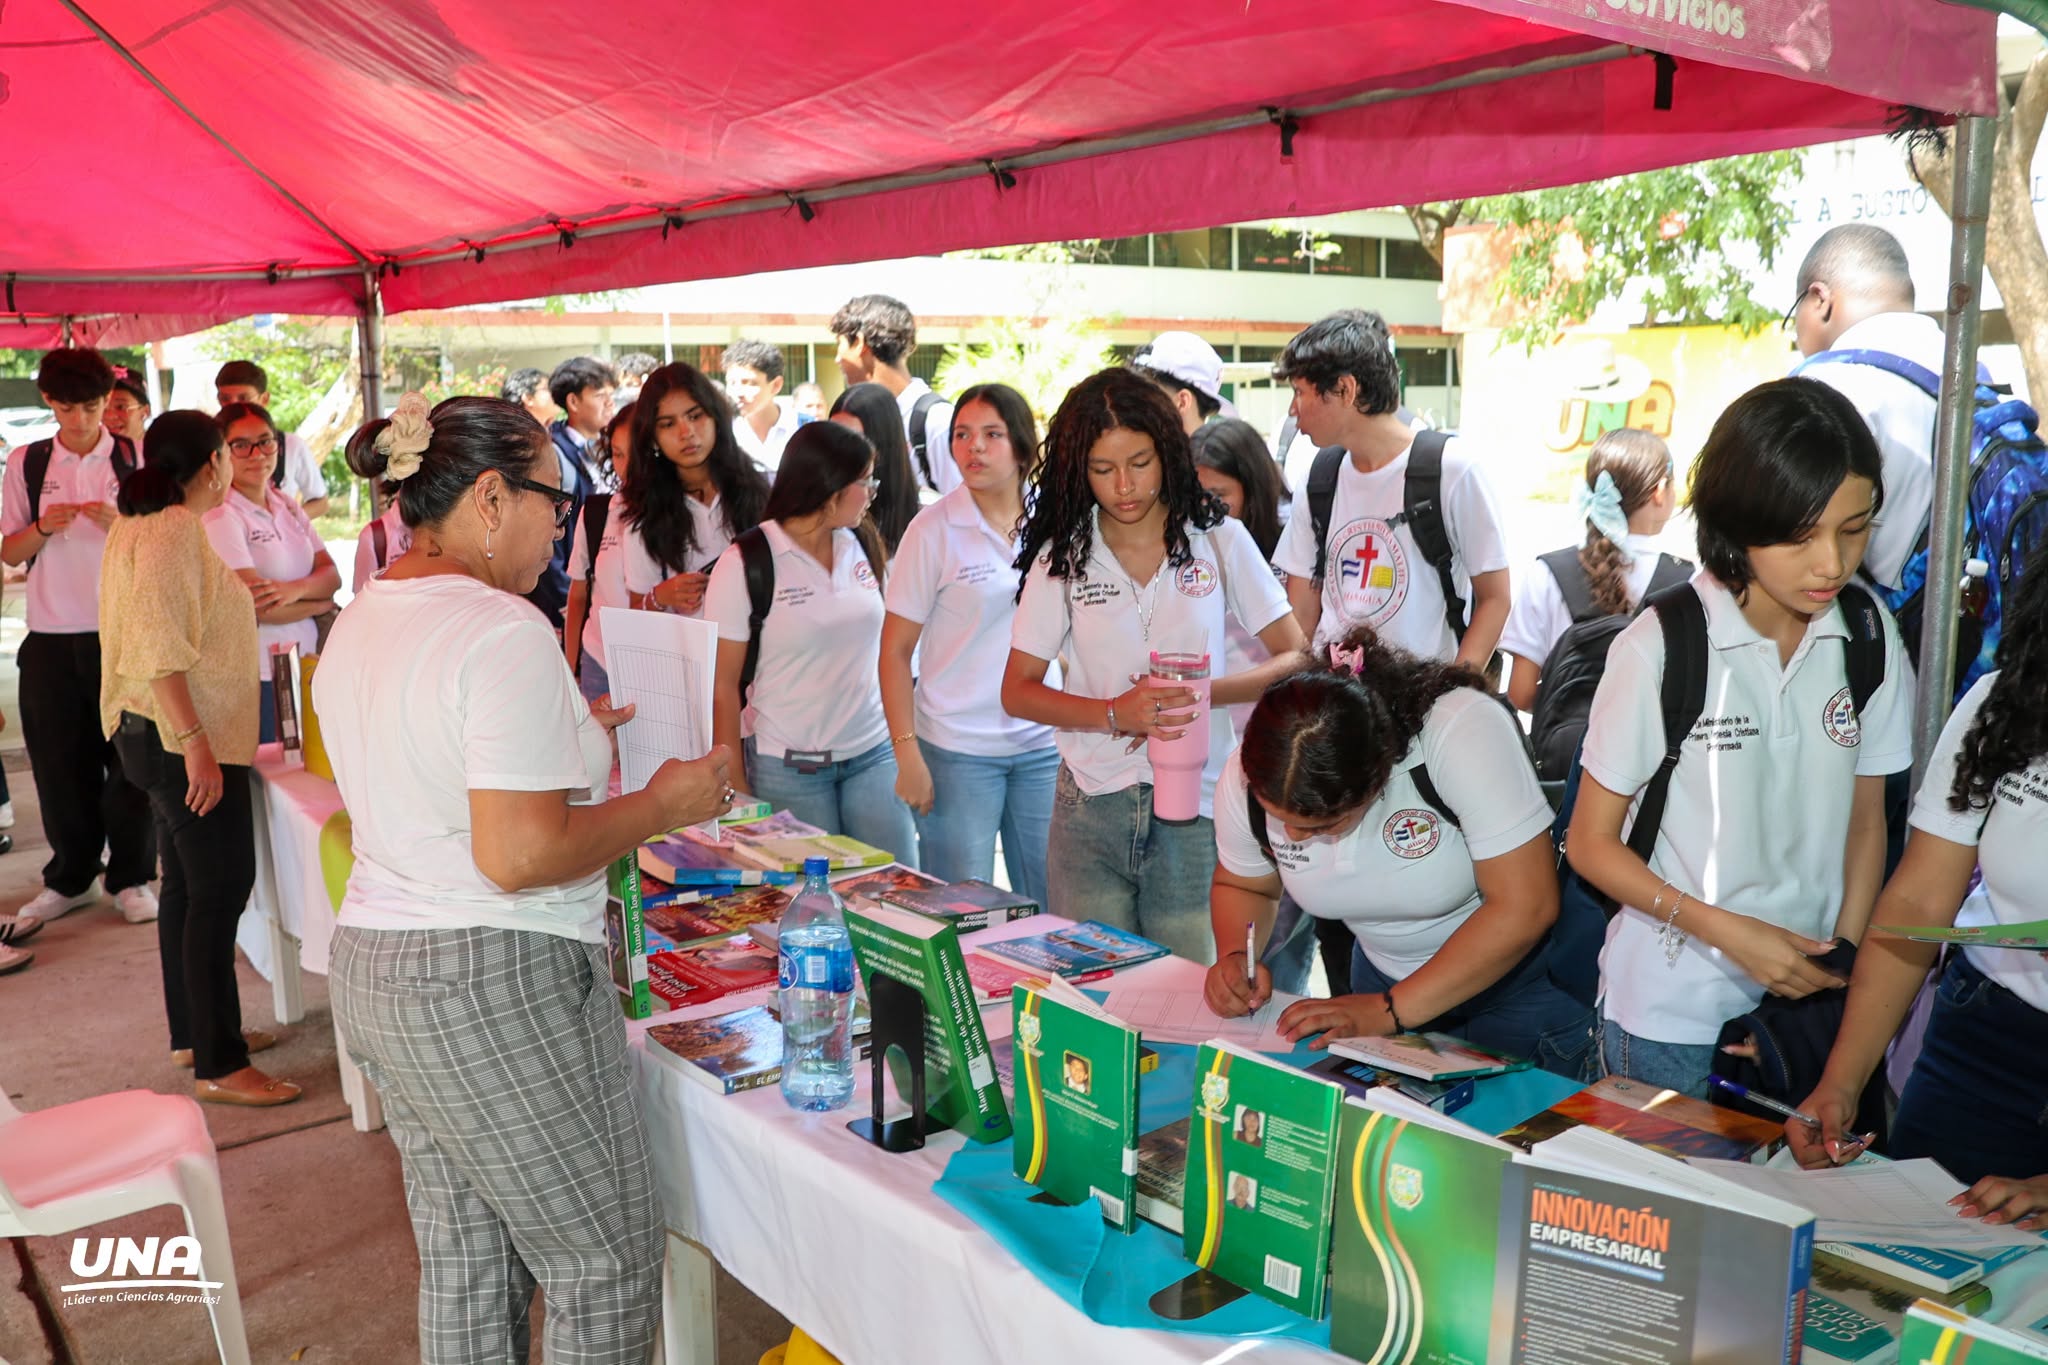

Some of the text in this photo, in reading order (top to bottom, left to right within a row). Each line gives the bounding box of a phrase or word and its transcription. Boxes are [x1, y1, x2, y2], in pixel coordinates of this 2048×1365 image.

[1544, 379, 1676, 453] UNA
[1706, 741, 1742, 752] Rormada
[625, 850, 637, 893] Animal
[630, 894, 638, 909] los
[631, 910, 640, 924] de
[940, 949, 963, 1024] Medioambiente
[956, 969, 976, 1025] Sustentable
[960, 1024, 968, 1038] de
[1531, 1188, 1671, 1253] INNOVACIÓN
[1529, 1222, 1667, 1270] EMPRESARIAL
